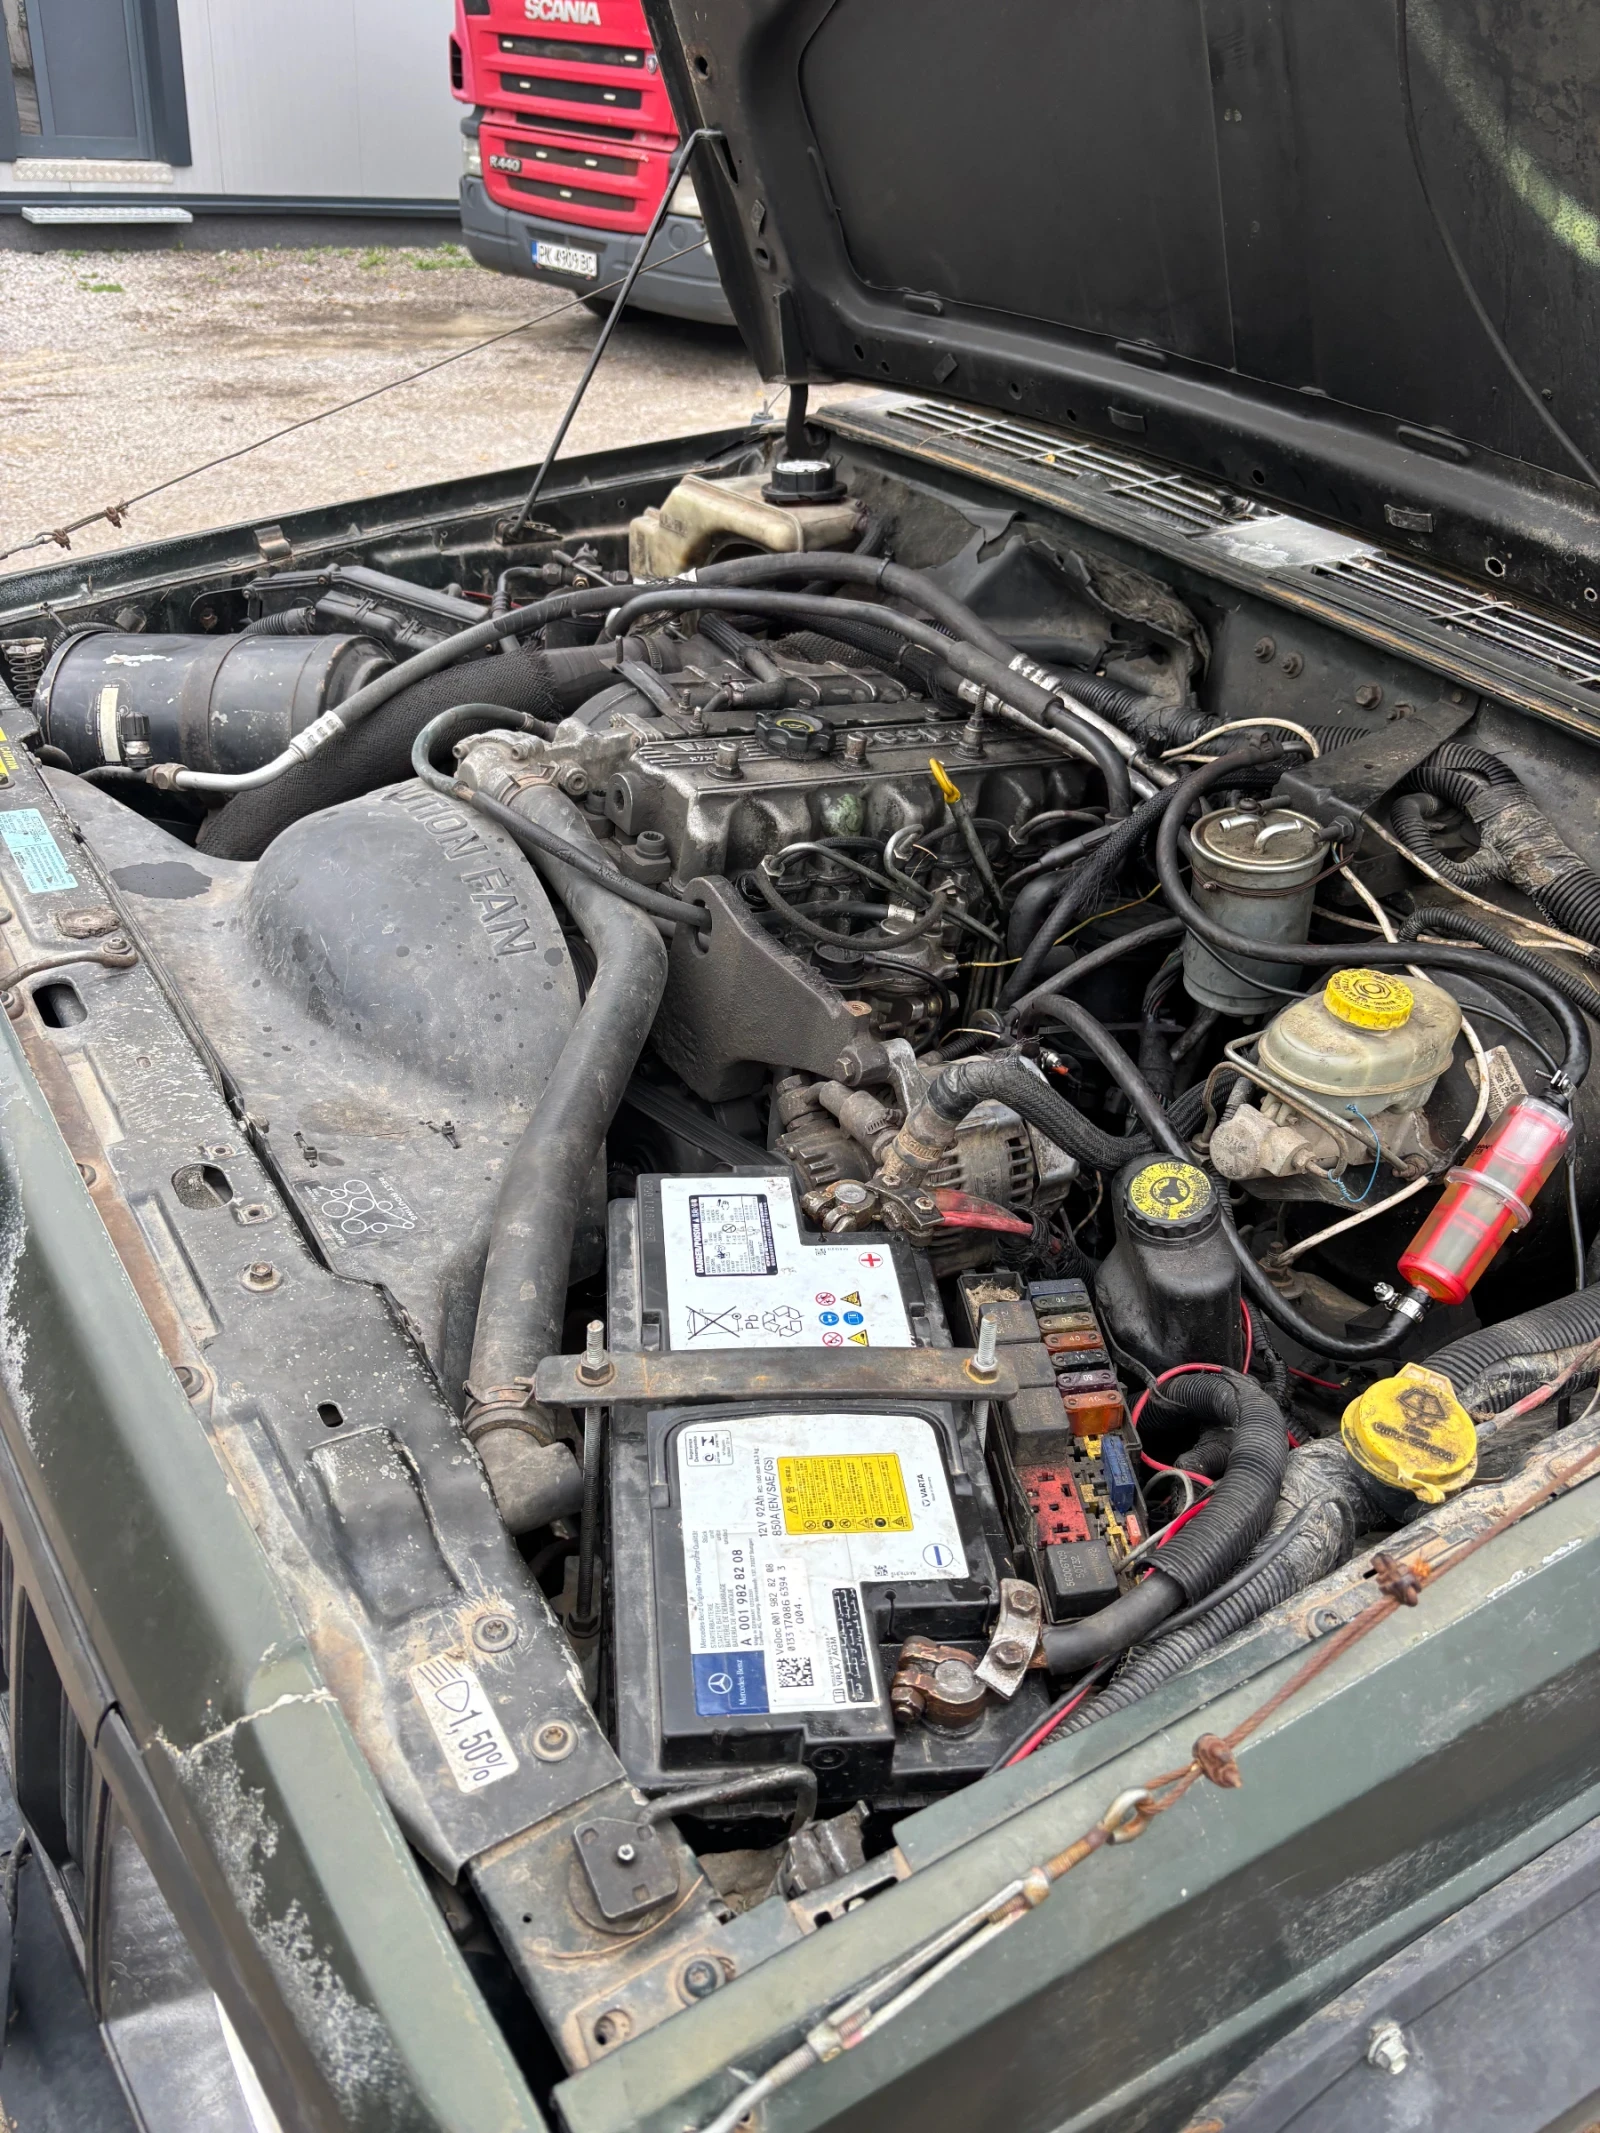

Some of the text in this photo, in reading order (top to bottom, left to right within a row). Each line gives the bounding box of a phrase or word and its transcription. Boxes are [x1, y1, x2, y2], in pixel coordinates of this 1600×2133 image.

[524, 0, 601, 26] SCANIA
[1, 745, 19, 770] CAUTION
[461, 867, 537, 956] FAN
[391, 1191, 419, 1221] ROUTING
[745, 1314, 760, 1331] Pb
[763, 1457, 782, 1536] 850A (EN/SAE/GS)
[916, 1473, 928, 1498] VARTA
[754, 1496, 766, 1517] 92Ah
[757, 1521, 768, 1537] 12V
[765, 1563, 774, 1573] 08
[767, 1578, 776, 1587] 82
[732, 1549, 752, 1646] A 001 982 82 08
[771, 1612, 781, 1625] 001
[774, 1628, 785, 1655] VeDoc
